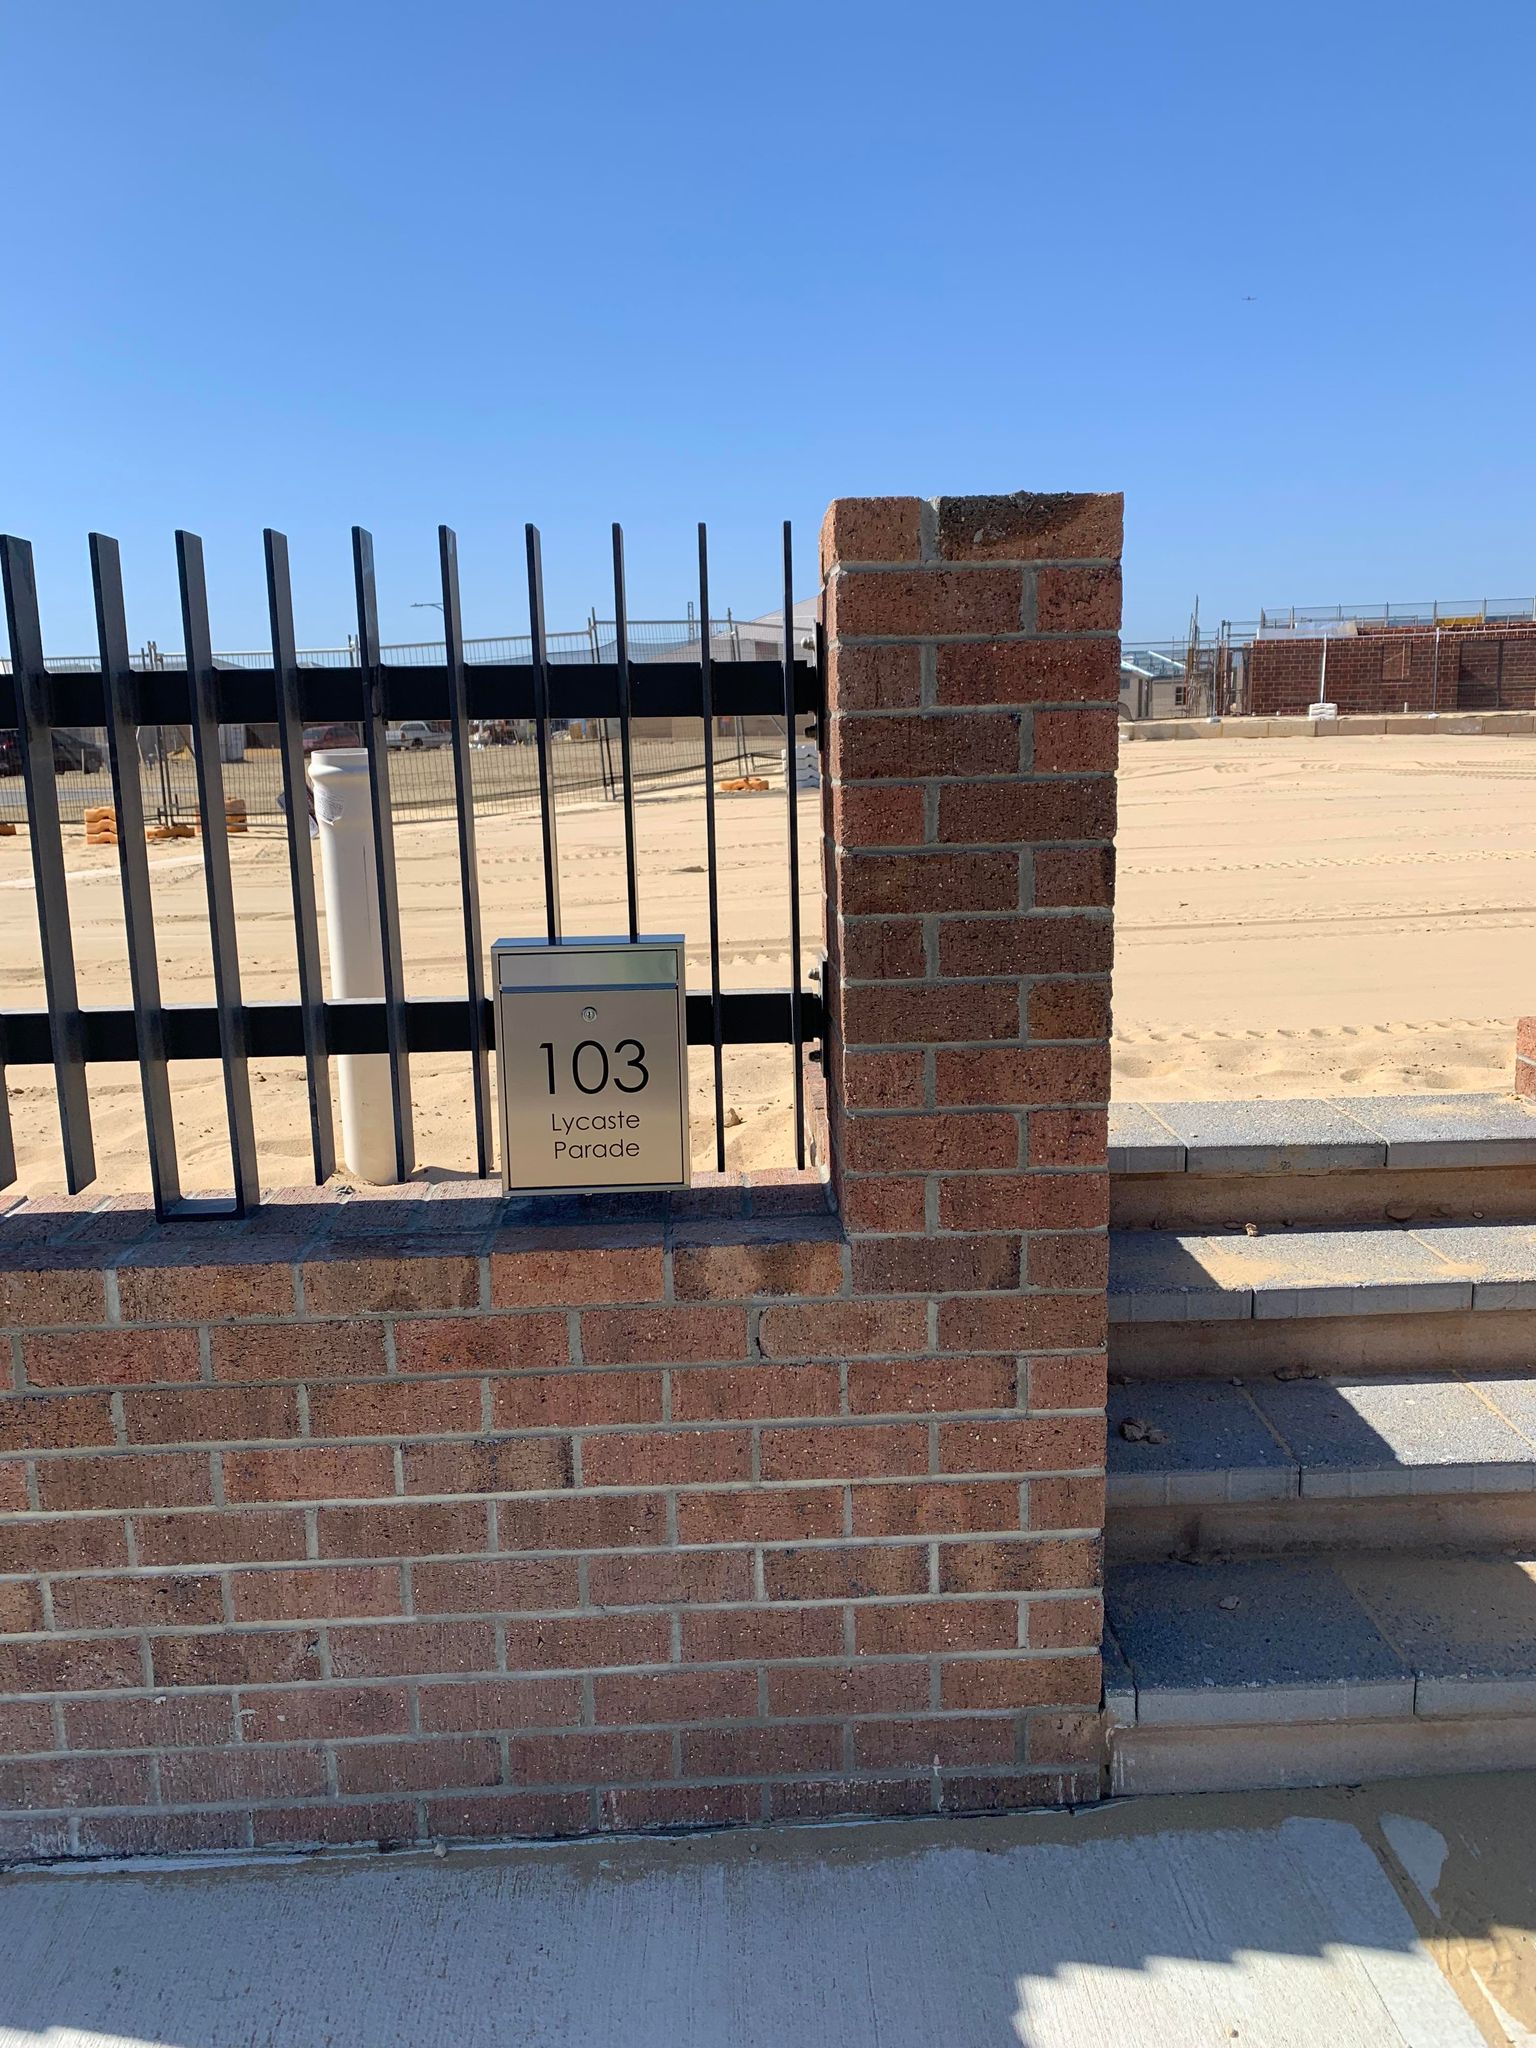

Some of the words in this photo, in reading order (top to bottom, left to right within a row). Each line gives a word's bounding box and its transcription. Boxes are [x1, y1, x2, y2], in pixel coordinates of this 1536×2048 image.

[539, 1038, 650, 1095] 103
[551, 1110, 641, 1136] Lycaste
[554, 1138, 641, 1160] Parade
